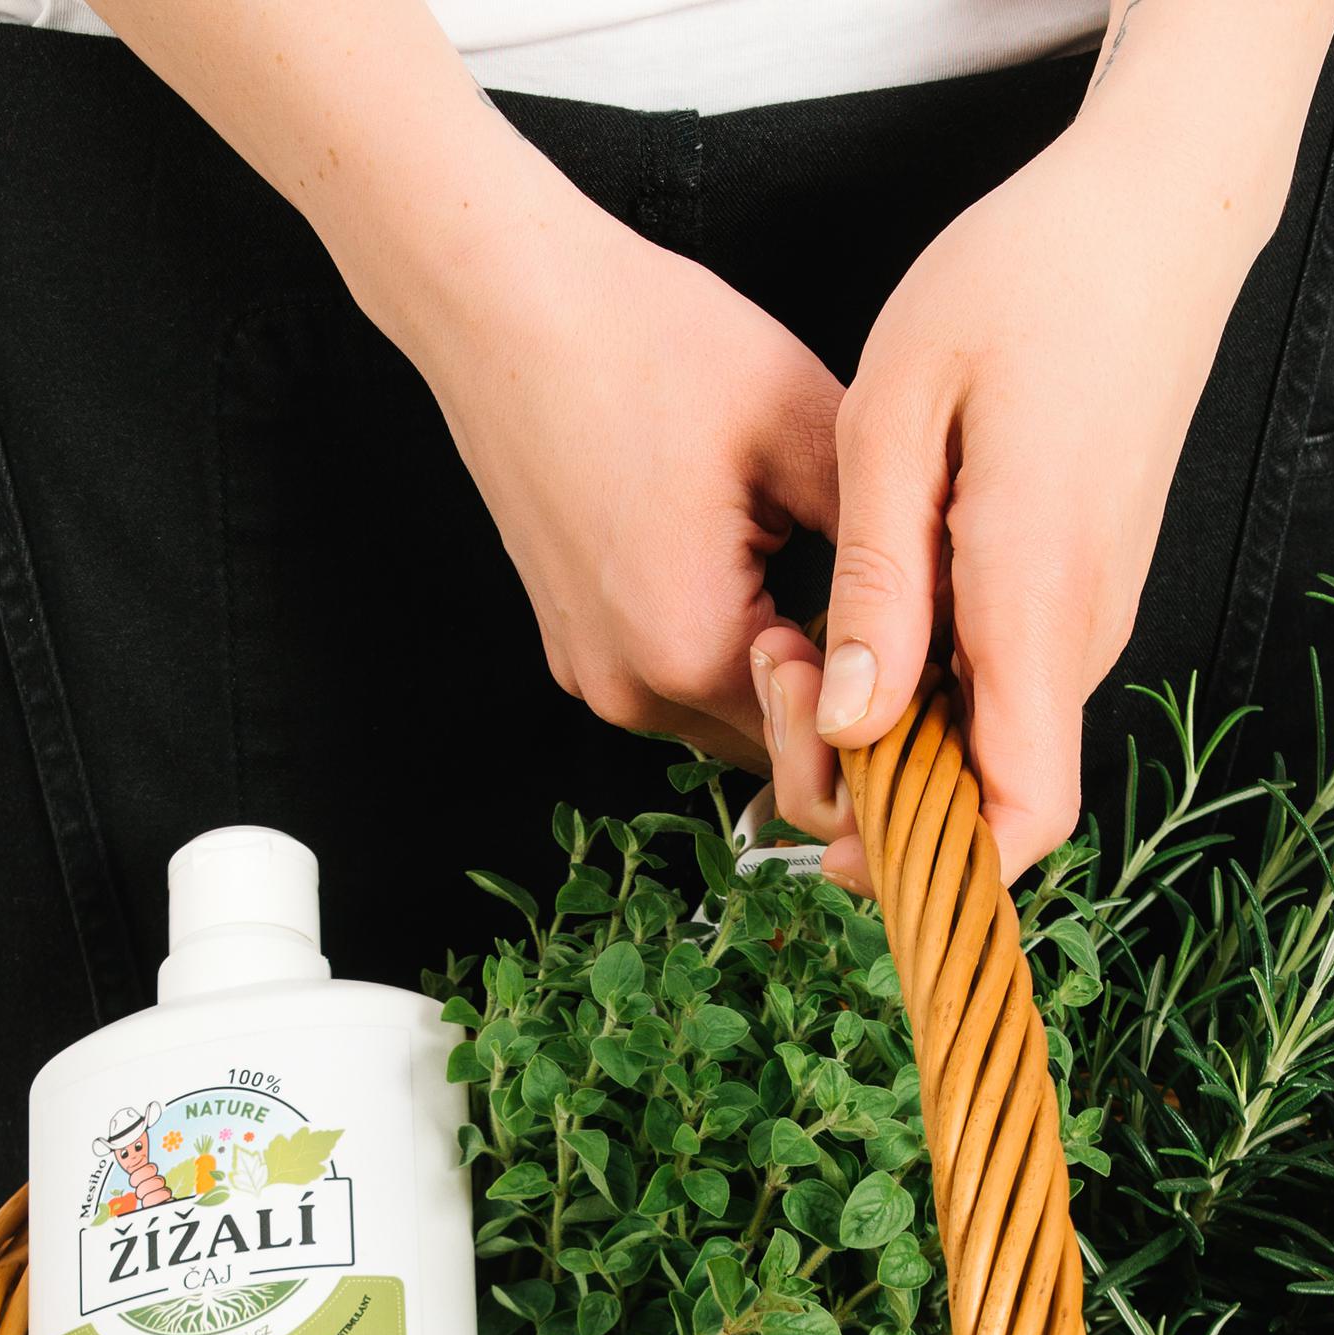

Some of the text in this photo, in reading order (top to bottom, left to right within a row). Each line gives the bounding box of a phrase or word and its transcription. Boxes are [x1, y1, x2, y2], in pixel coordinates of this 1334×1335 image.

[228, 1068, 282, 1094] 100%
[185, 1099, 270, 1124] NATURE
[79, 1158, 107, 1220] Mesiho
[108, 1191, 317, 1283] ŽÍŽALÍ
[183, 1264, 232, 1290] ČAJ
